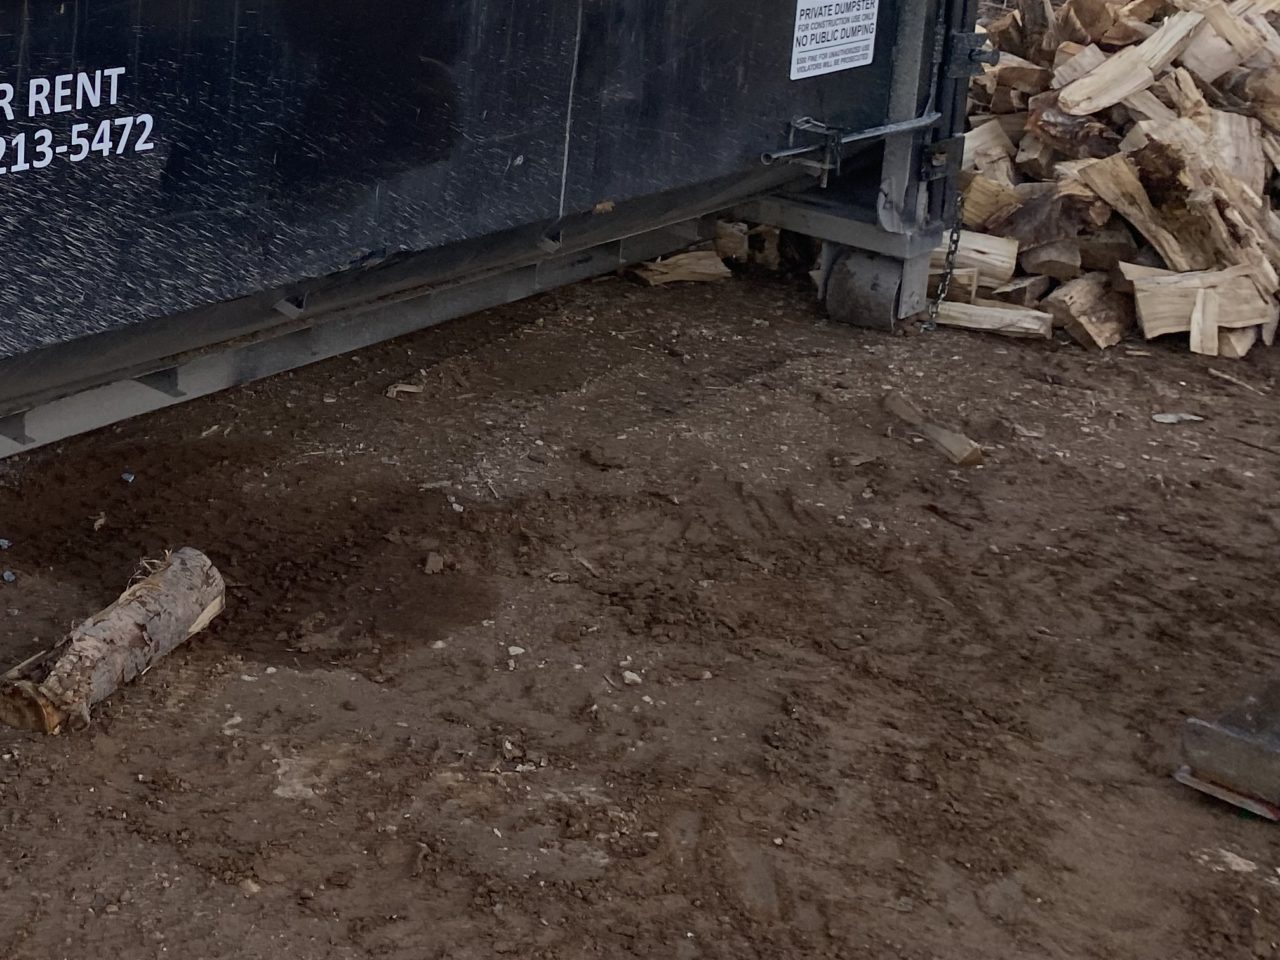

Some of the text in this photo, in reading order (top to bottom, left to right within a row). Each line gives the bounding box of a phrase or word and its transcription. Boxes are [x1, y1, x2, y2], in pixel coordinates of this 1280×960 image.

[797, 12, 875, 33] FOR CONSTRUCTION USE ONLY
[800, 4, 833, 20] PRIVATE
[795, 22, 875, 48] NO PUBLIC DUMPING
[28, 67, 126, 117] RENT
